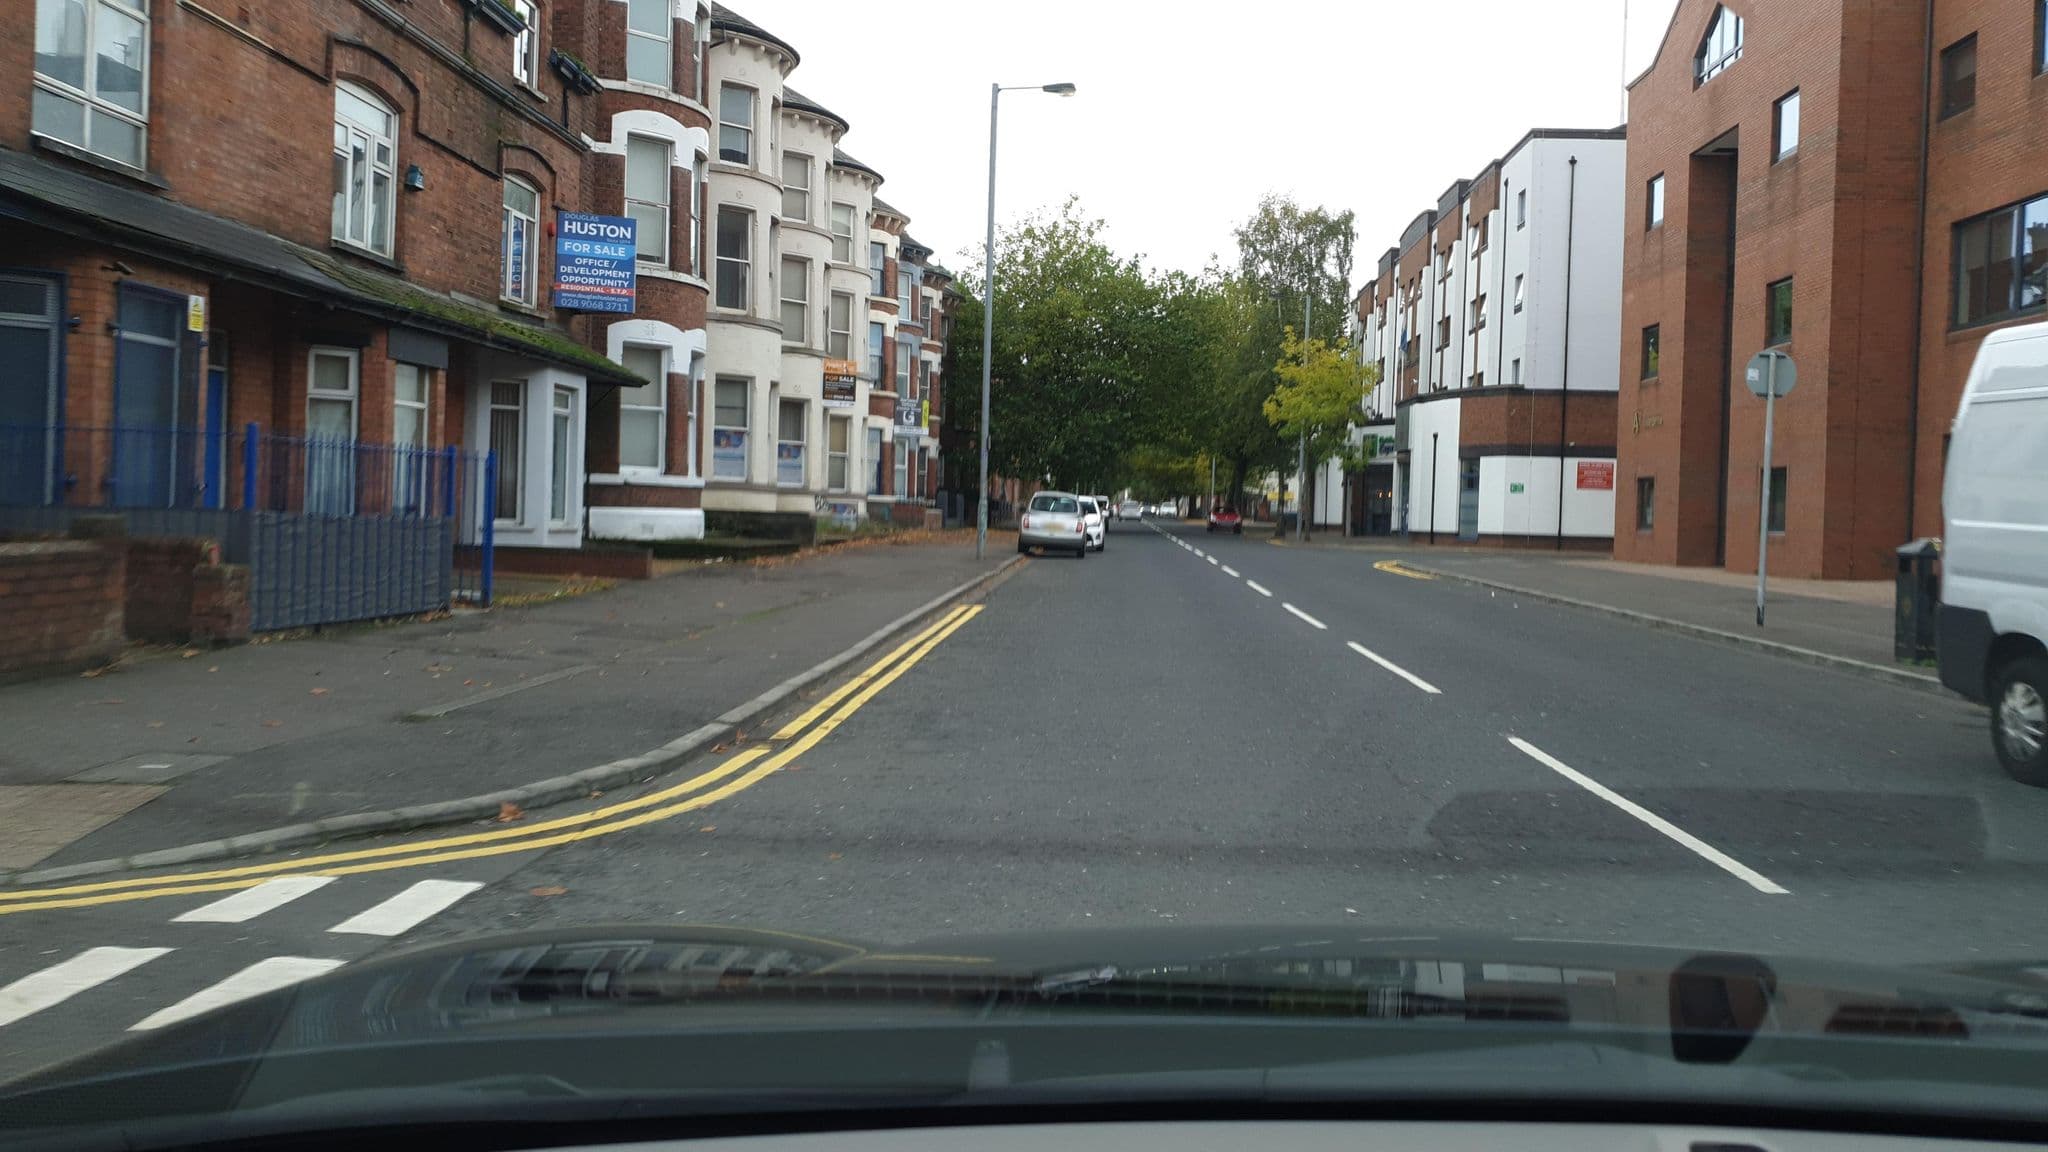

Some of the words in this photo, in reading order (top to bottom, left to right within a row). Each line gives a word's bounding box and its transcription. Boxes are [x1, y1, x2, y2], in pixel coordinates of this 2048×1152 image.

[564, 213, 599, 222] DOUGLAS
[564, 220, 632, 239] HUSTON
[564, 242, 590, 253] FOR
[594, 245, 626, 257] SALE
[574, 257, 610, 268] OFFICE
[611, 260, 618, 269] /
[560, 265, 631, 279] DEVELOPMENT
[560, 283, 605, 293] RESIDENTIAL
[561, 275, 629, 288] OPPORTUNITY
[561, 298, 579, 307] 028
[581, 299, 604, 309] 9068
[606, 301, 628, 312] 3711
